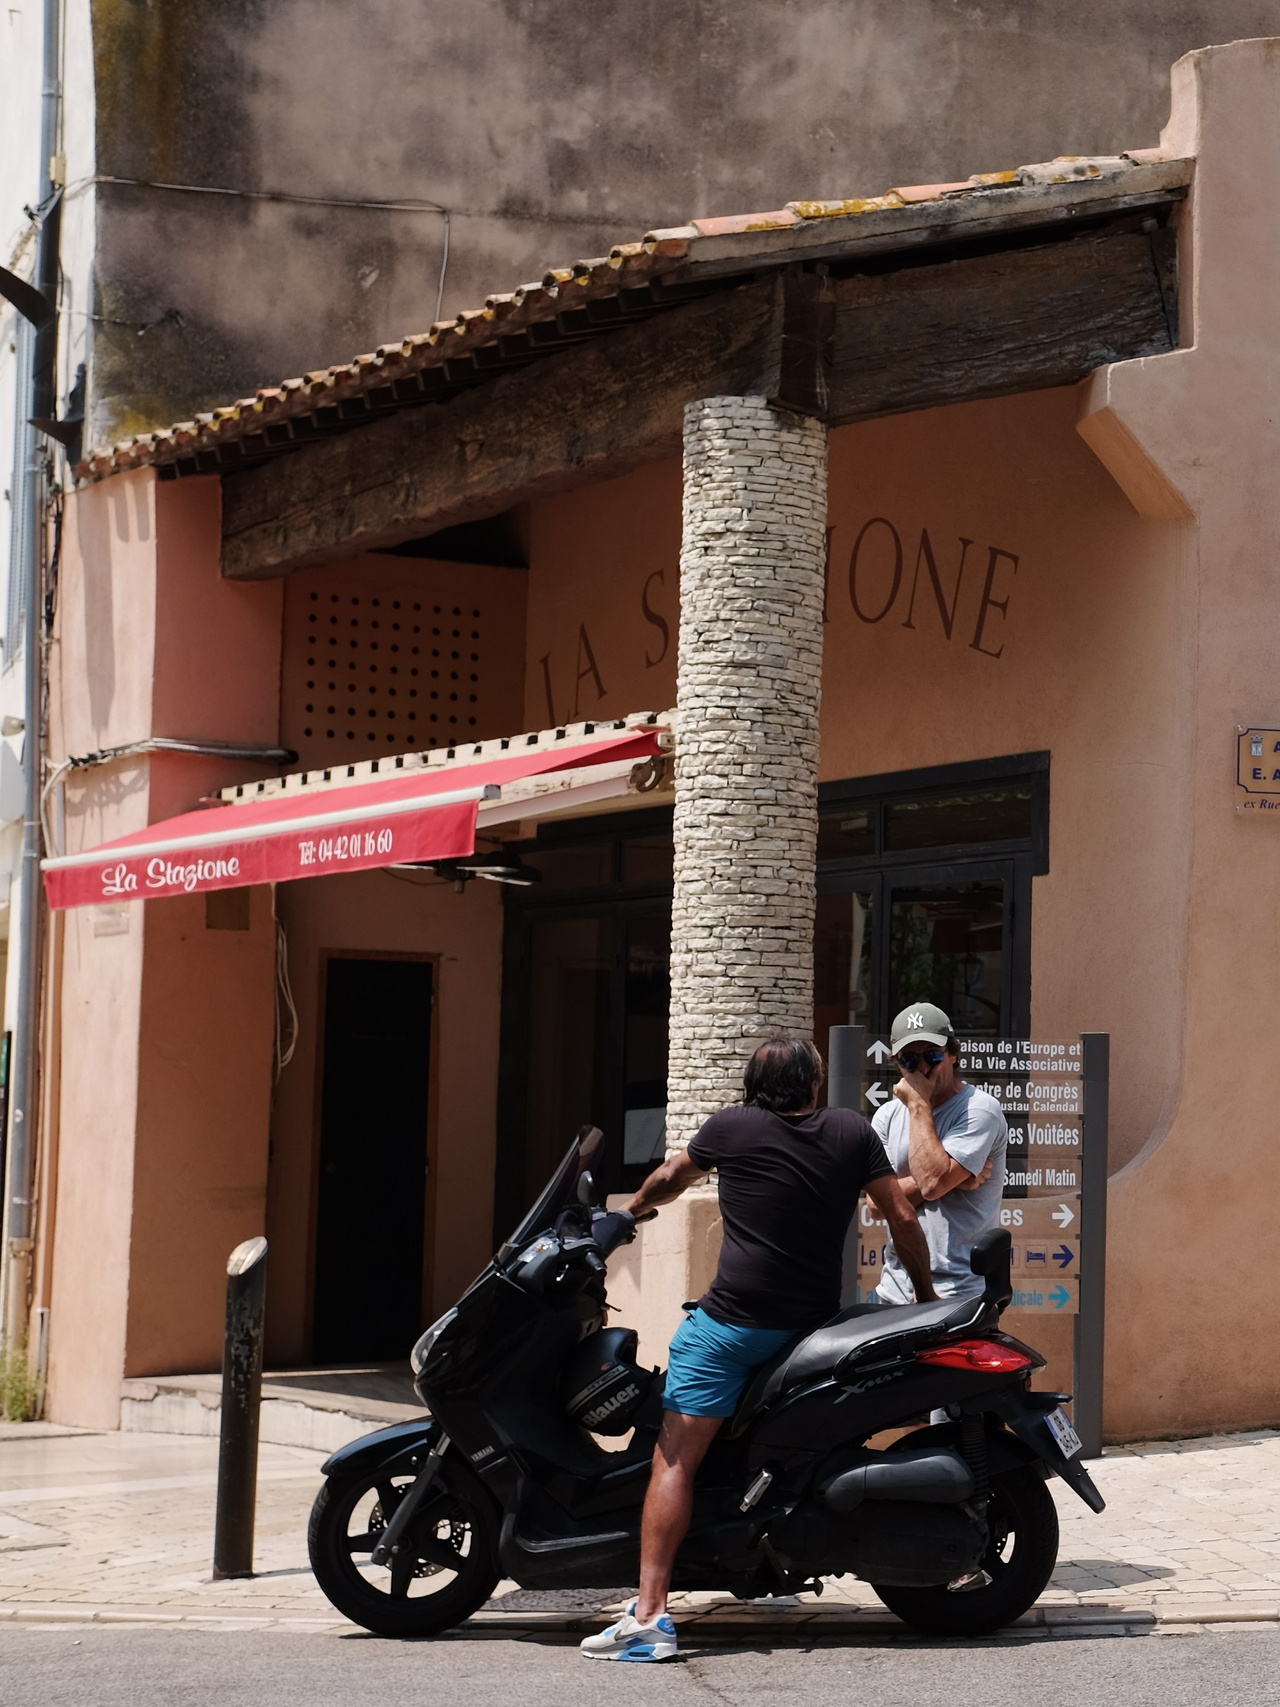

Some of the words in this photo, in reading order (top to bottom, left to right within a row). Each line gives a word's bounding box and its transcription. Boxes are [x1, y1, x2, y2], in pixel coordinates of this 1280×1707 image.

[539, 623, 607, 728] LA
[1252, 768, 1267, 780] E.
[1244, 801, 1256, 809] ex
[1259, 799, 1280, 810] Rue
[101, 863, 138, 895] La
[145, 857, 240, 891] Stazione
[318, 838, 333, 862] 04
[334, 835, 348, 859] 42
[350, 833, 362, 858] 01
[363, 830, 376, 856] 16
[377, 828, 393, 854] 60
[907, 1012, 923, 1029] NY
[959, 1040, 993, 1053] aison
[997, 1040, 1012, 1054] de
[1016, 1041, 1065, 1056] l'Europe
[1069, 1043, 1081, 1055] et
[959, 1058, 968, 1069] e
[971, 1056, 982, 1069] la
[986, 1056, 1006, 1070] Vie
[1010, 1057, 1081, 1072] Associative
[1005, 1082, 1021, 1099] de
[1026, 1081, 1078, 1102] Congrès
[1001, 1101, 1030, 1111] ustau
[1033, 1101, 1078, 1112] Calendal
[1027, 1123, 1079, 1146] Voûtées
[1003, 1168, 1042, 1186] Samedi
[1045, 1168, 1076, 1186] Matin
[861, 1245, 876, 1266] Le
[1010, 1289, 1043, 1306] dicale
